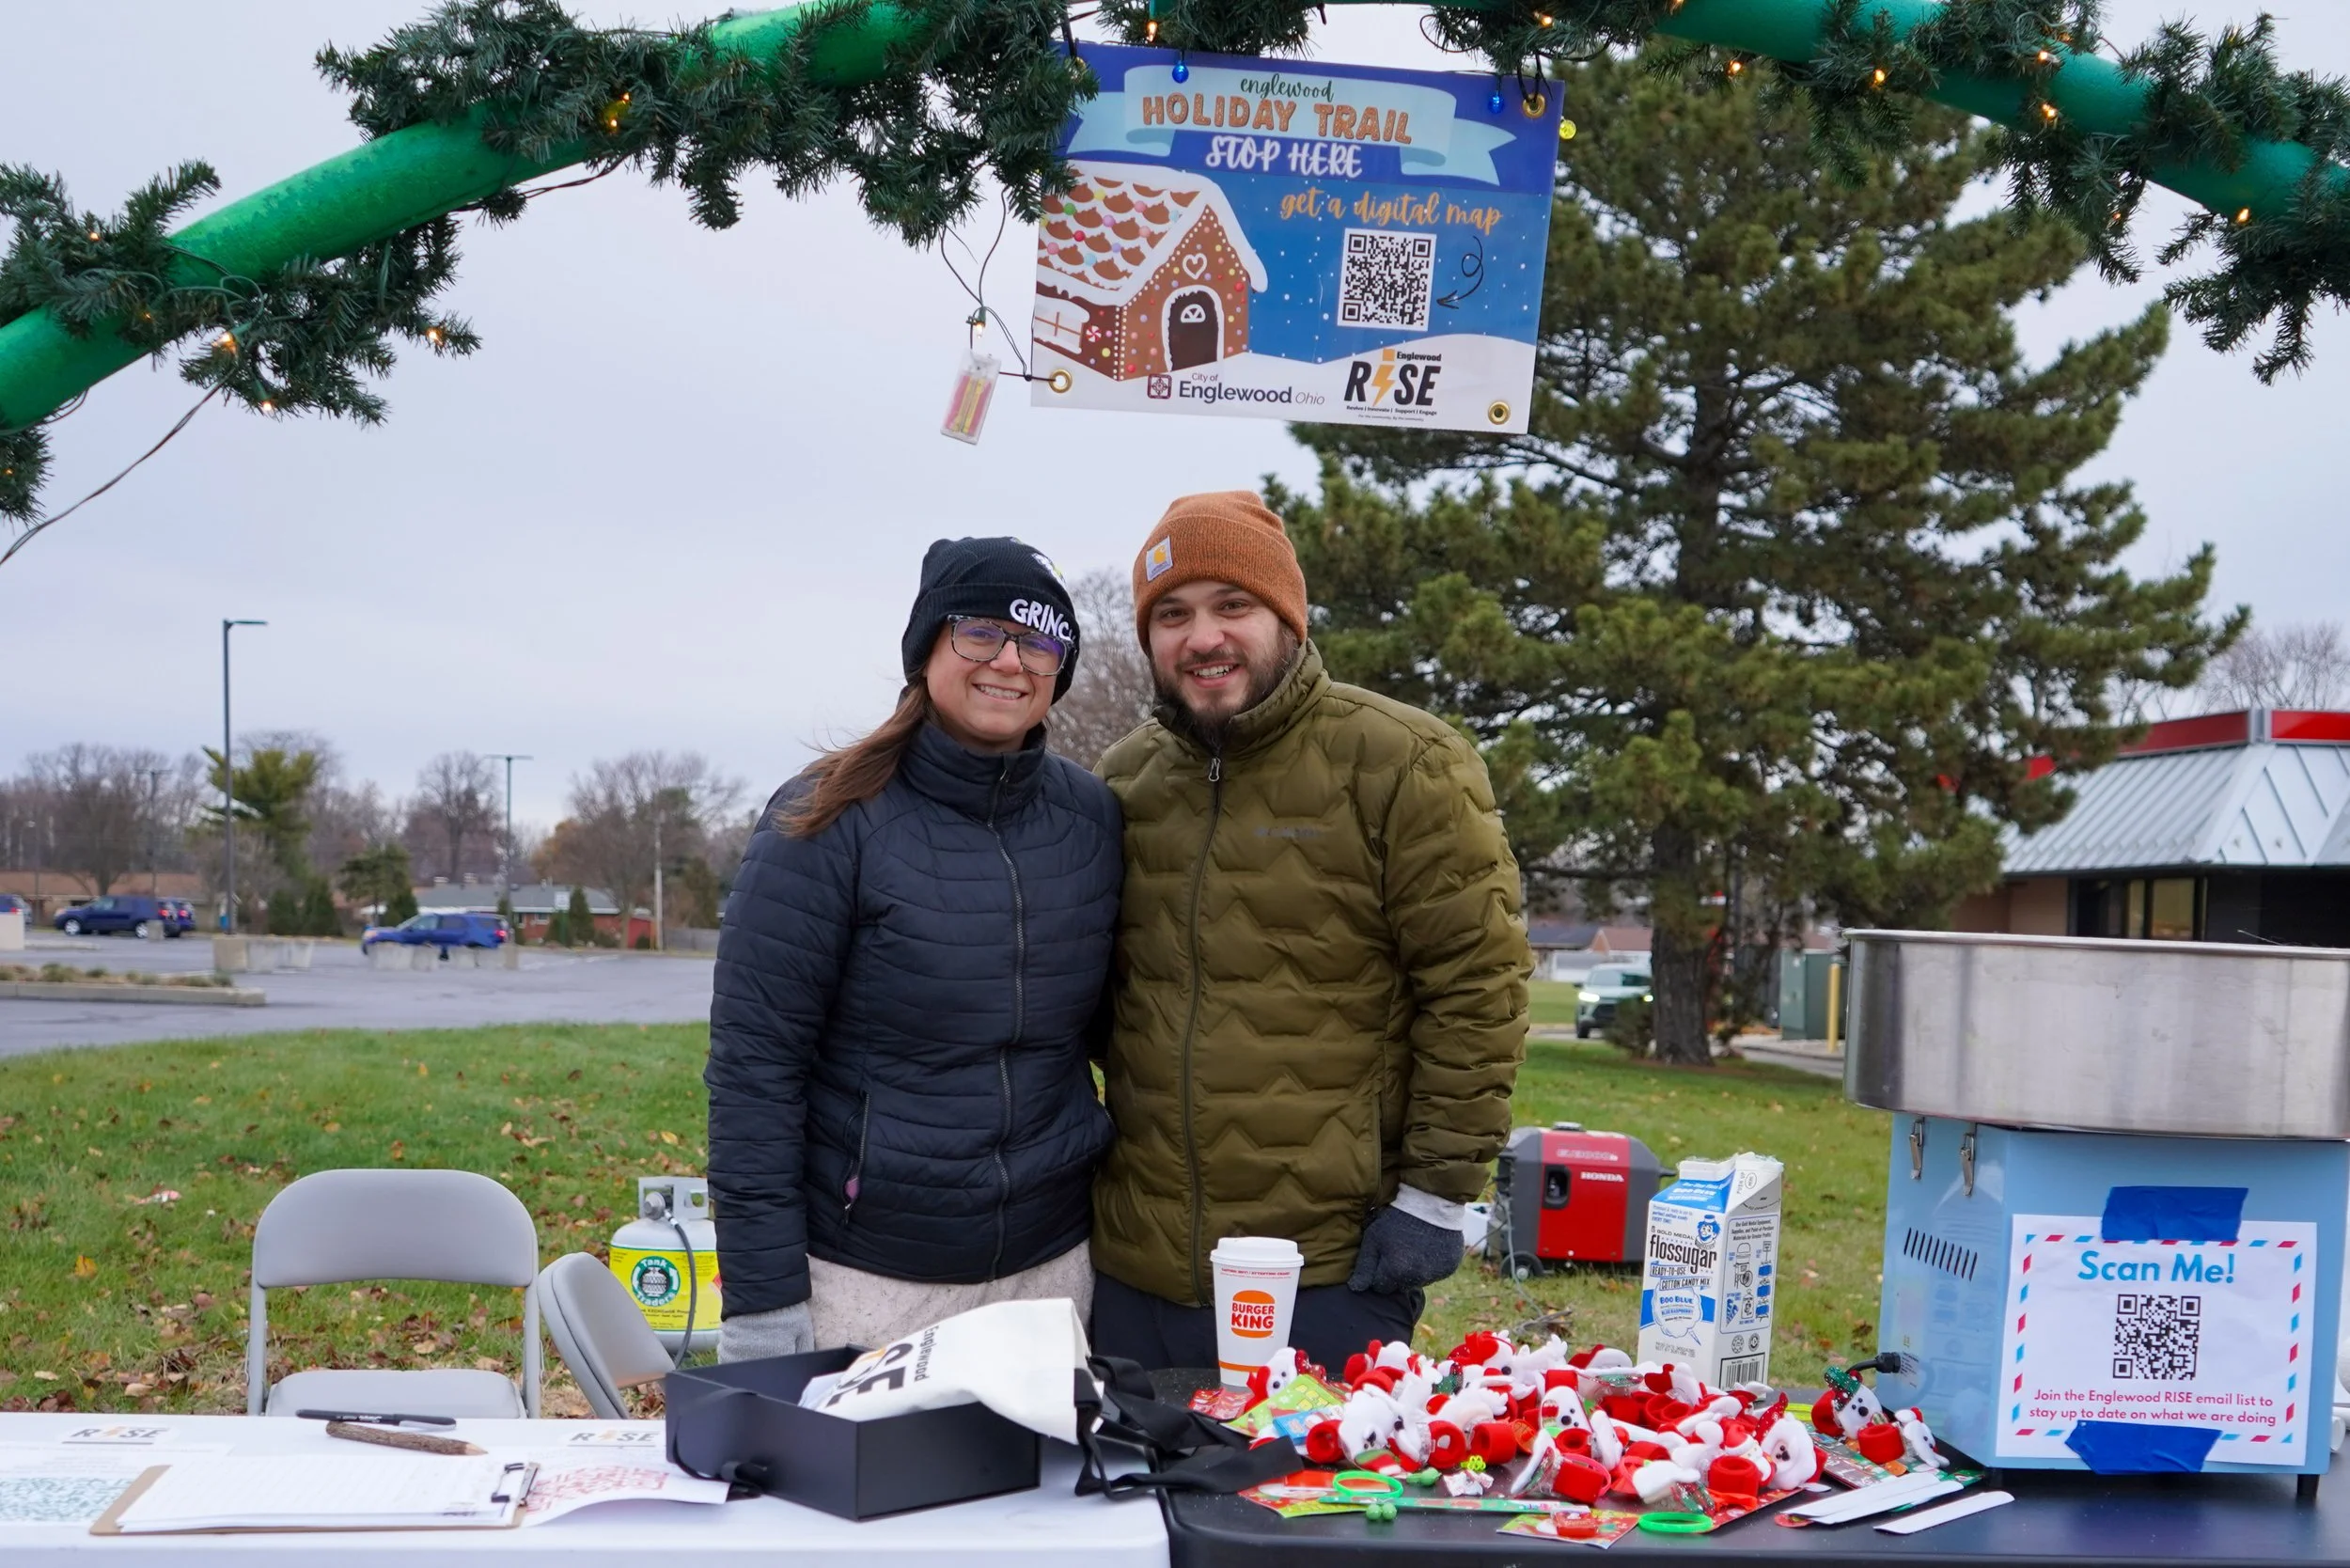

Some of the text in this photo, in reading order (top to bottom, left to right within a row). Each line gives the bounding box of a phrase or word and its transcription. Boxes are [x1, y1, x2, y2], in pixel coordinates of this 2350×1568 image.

[1240, 72, 1335, 102] englewood
[1142, 92, 1412, 144] HOLIDAY TRAIL
[1205, 135, 1363, 178] STOP HERE
[1280, 186, 1504, 236] get a digital map
[1397, 352, 1442, 362] Englewood
[1191, 372, 1219, 383] City of
[1179, 380, 1325, 406] Englewood Ohio
[1580, 1171, 1624, 1183] HONDA
[1674, 1231, 1694, 1240] MEDAL
[1650, 1234, 1717, 1274] flossugar
[640, 1259, 667, 1267] Tank
[1652, 1265, 1686, 1276] READY-TO-USE
[2077, 1249, 2234, 1283] Scan Me!
[1662, 1279, 1680, 1290] COTTON
[1682, 1278, 1699, 1288] CANDY
[636, 1291, 675, 1307] Traders
[1232, 1303, 1275, 1315] BURGER
[1231, 1313, 1274, 1329] KING
[914, 1325, 939, 1382] Englewood
[2034, 1389, 2273, 1406] Join the Englewood RISE email list to
[2029, 1407, 2276, 1427] stay up to date on what we are doing
